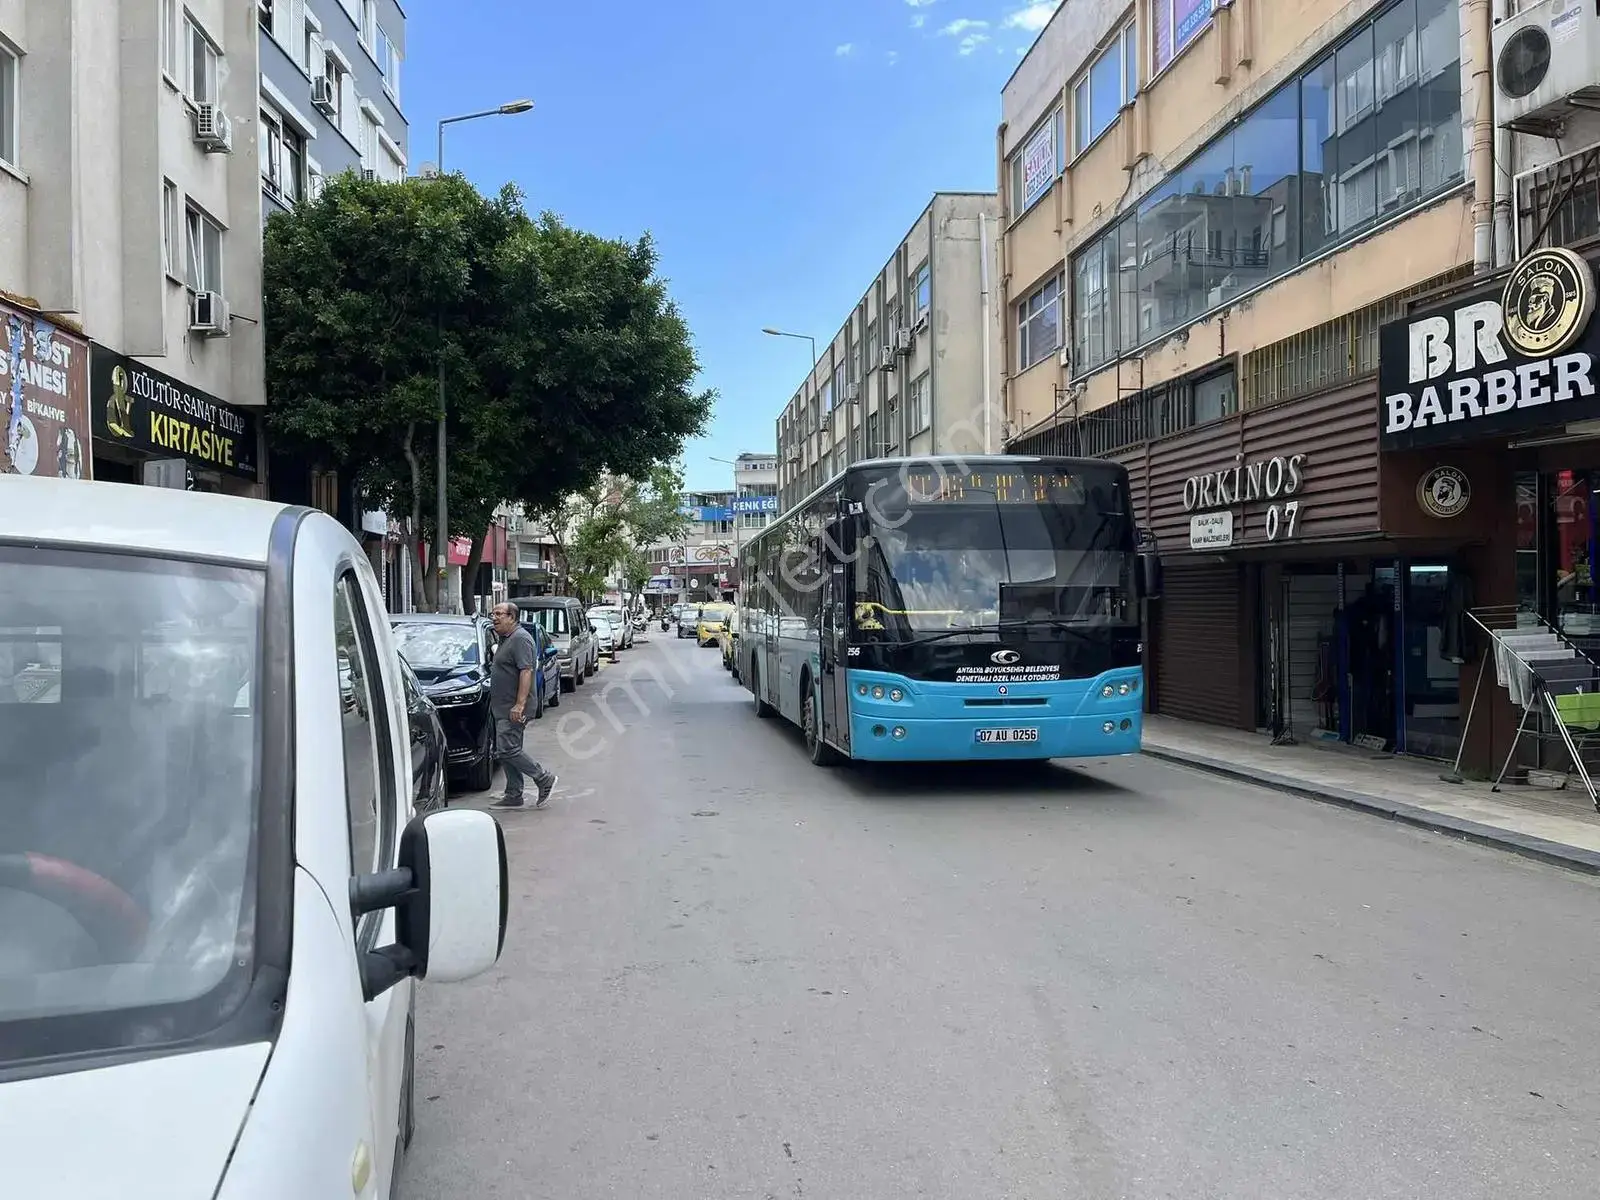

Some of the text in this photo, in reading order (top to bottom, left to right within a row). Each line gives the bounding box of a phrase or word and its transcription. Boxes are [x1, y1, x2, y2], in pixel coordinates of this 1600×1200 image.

[1518, 260, 1564, 287] SALON
[132, 371, 245, 435] KÜLTÜR-SANAT KİTAP
[1385, 352, 1596, 434] BARBER
[151, 411, 234, 467] KIRTASİYE
[1183, 453, 1303, 511] ORKİNOS
[733, 501, 760, 511] RENK
[1266, 501, 1299, 540] 07
[992, 674, 1009, 682] ÖZEL
[1010, 674, 1027, 682] HALK
[980, 729, 1037, 741] 07 AU 0256
